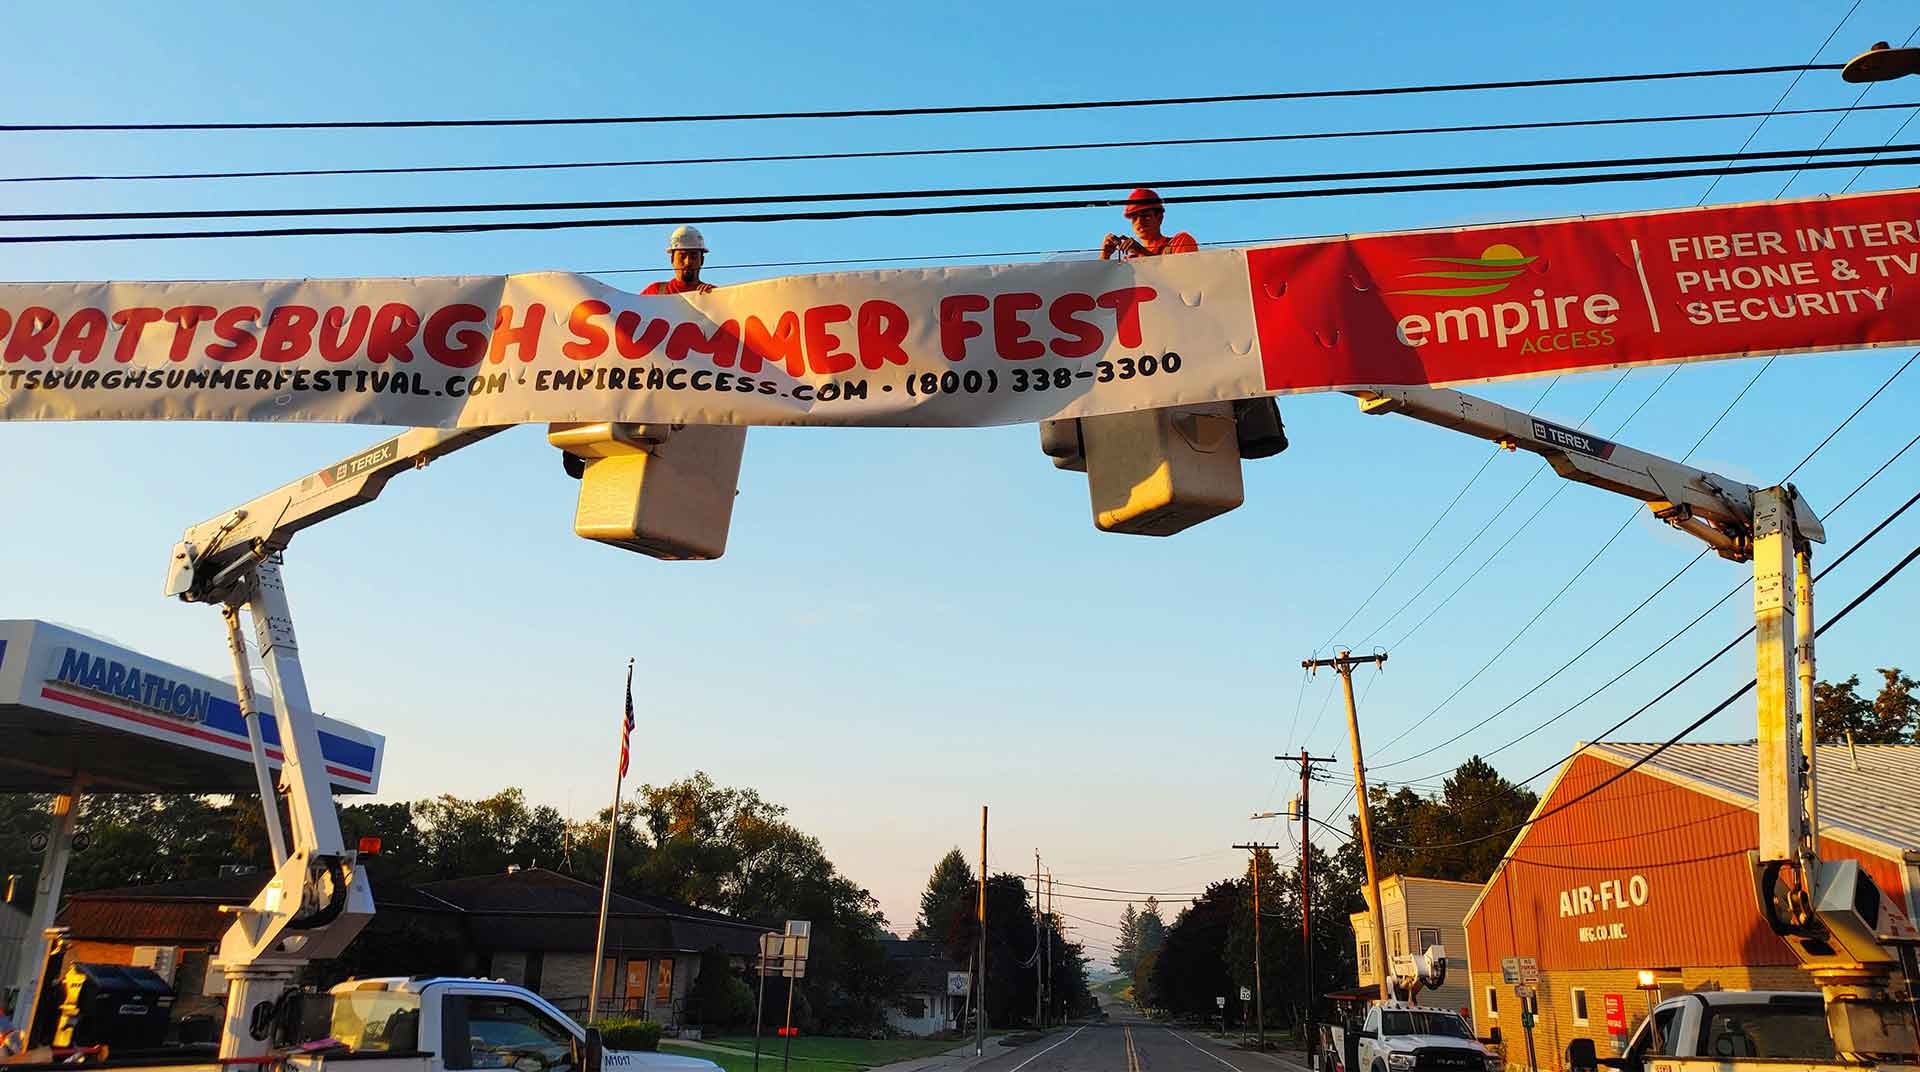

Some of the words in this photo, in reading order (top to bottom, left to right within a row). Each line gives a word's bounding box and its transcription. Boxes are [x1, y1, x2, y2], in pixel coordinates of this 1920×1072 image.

[1668, 231, 1788, 262] FIBER
[1796, 218, 1920, 252] INTER
[1675, 261, 1819, 294] PHONE
[1831, 258, 1861, 281] &
[1864, 252, 1918, 277] TV
[1396, 288, 1620, 348] empire
[1685, 286, 1888, 326] SECURITY
[0, 303, 546, 369] RATTSBURGH
[562, 299, 910, 379] SUMMER
[940, 286, 1158, 363] FEST
[1519, 328, 1616, 356] ACCESS
[535, 366, 868, 402] EMPIREACCESS.COM
[906, 368, 999, 398] (800)
[1011, 352, 1182, 393] 338-3300
[350, 446, 391, 473] TEREX
[1548, 428, 1592, 452] TEREX
[57, 648, 212, 722] MARATHON
[1559, 874, 1649, 918] AIR-FLO
